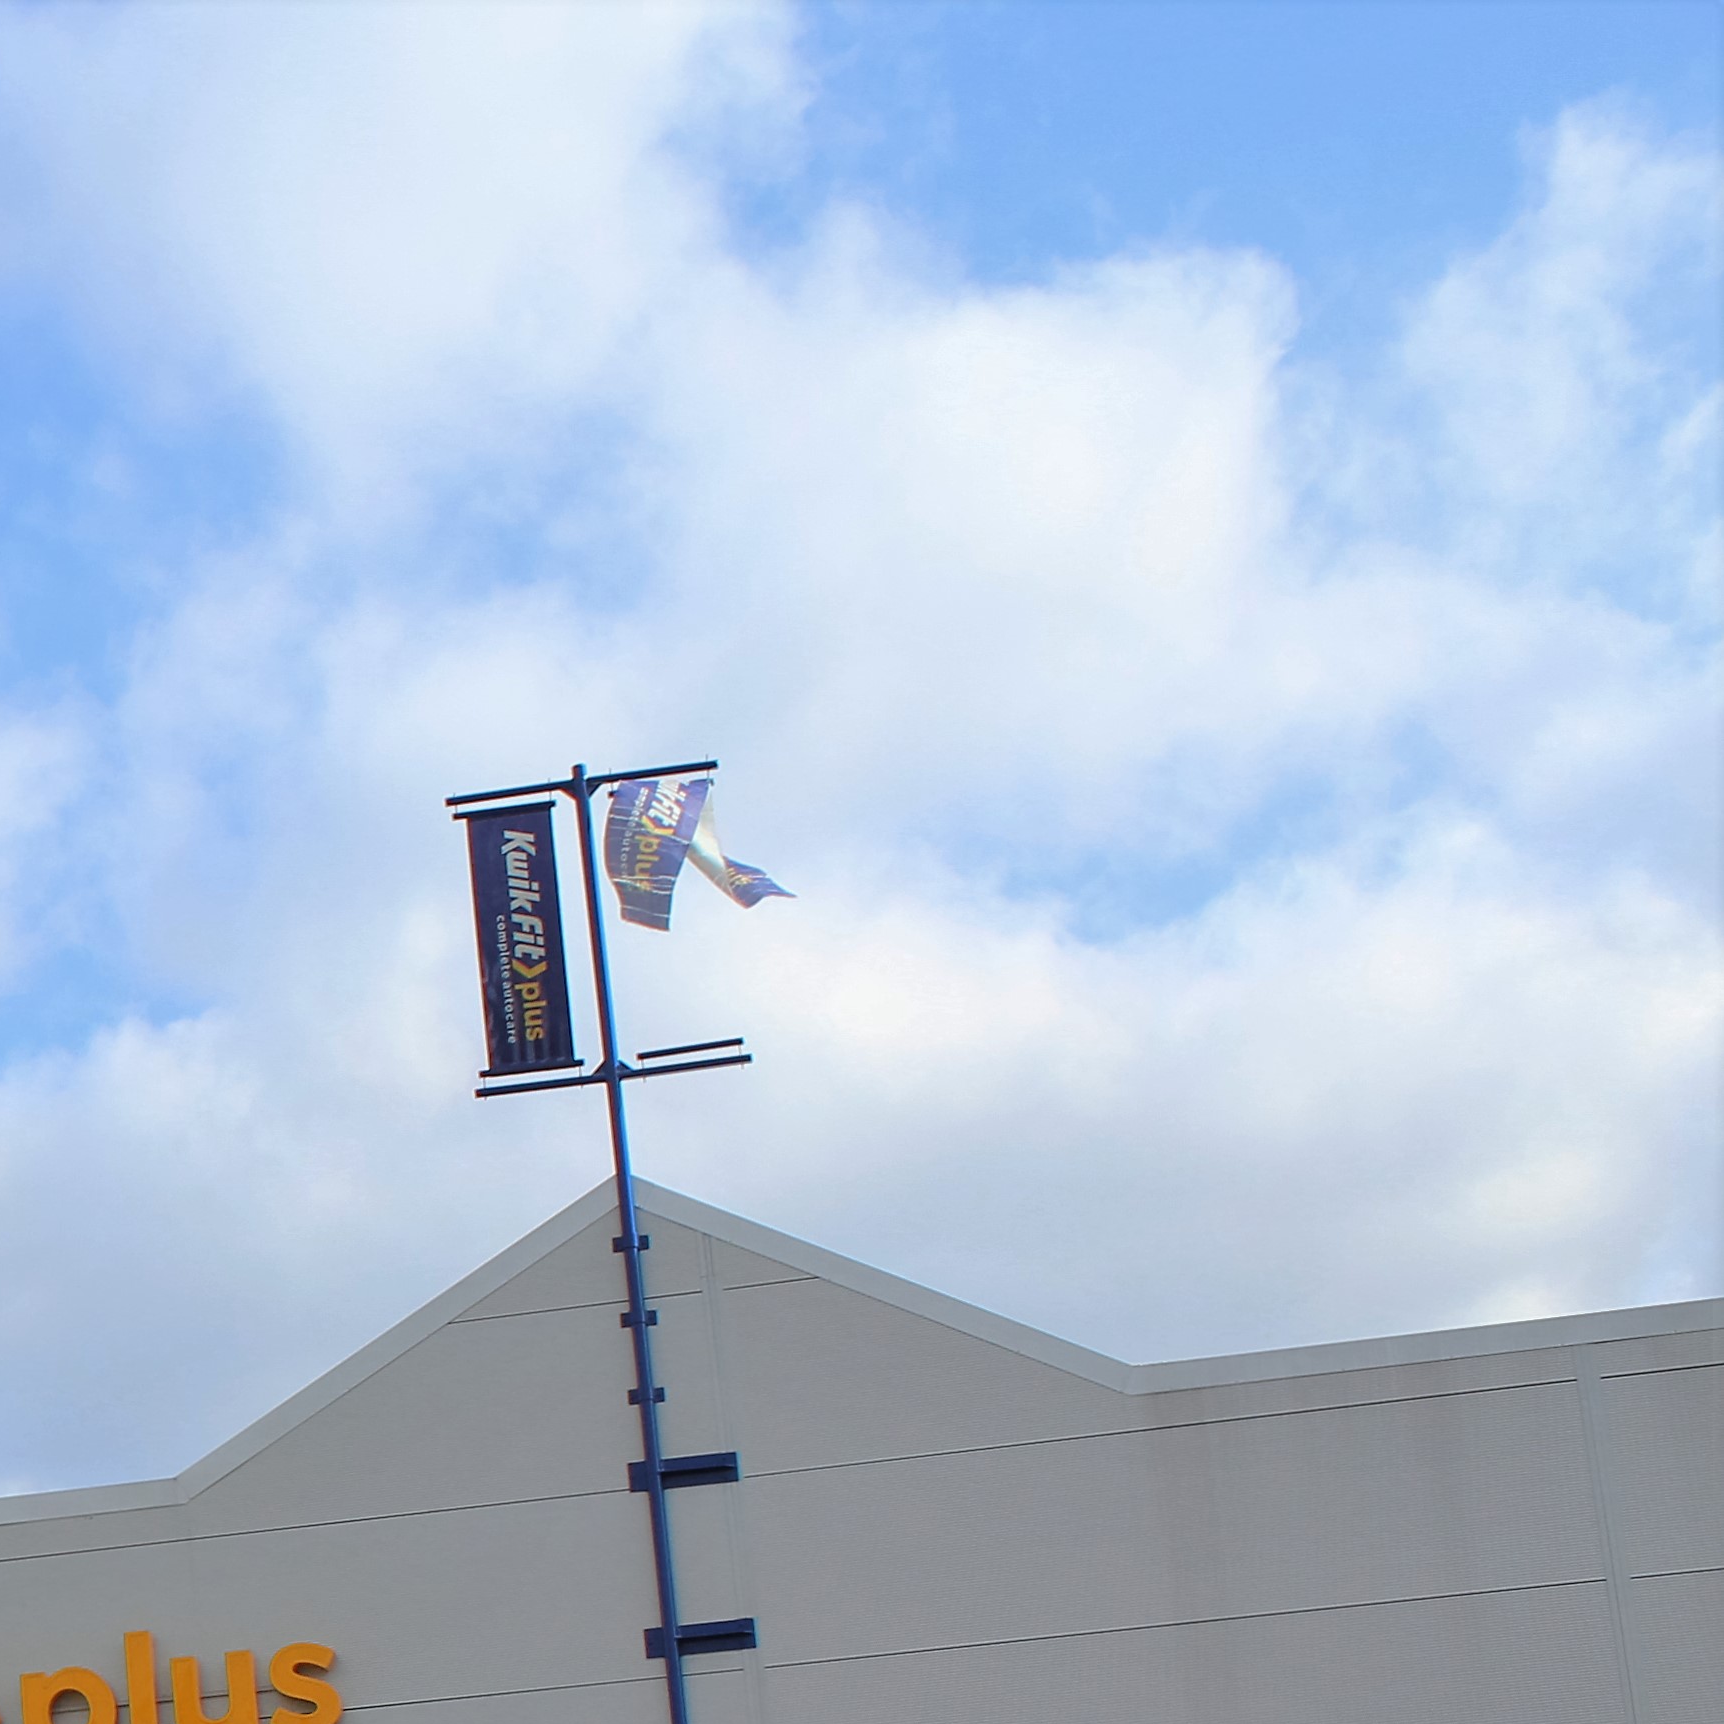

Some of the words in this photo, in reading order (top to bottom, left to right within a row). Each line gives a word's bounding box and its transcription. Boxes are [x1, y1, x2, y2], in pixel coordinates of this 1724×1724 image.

[496, 914, 512, 979] complete
[503, 980, 517, 1044] autocare
[514, 980, 548, 1041] plus
